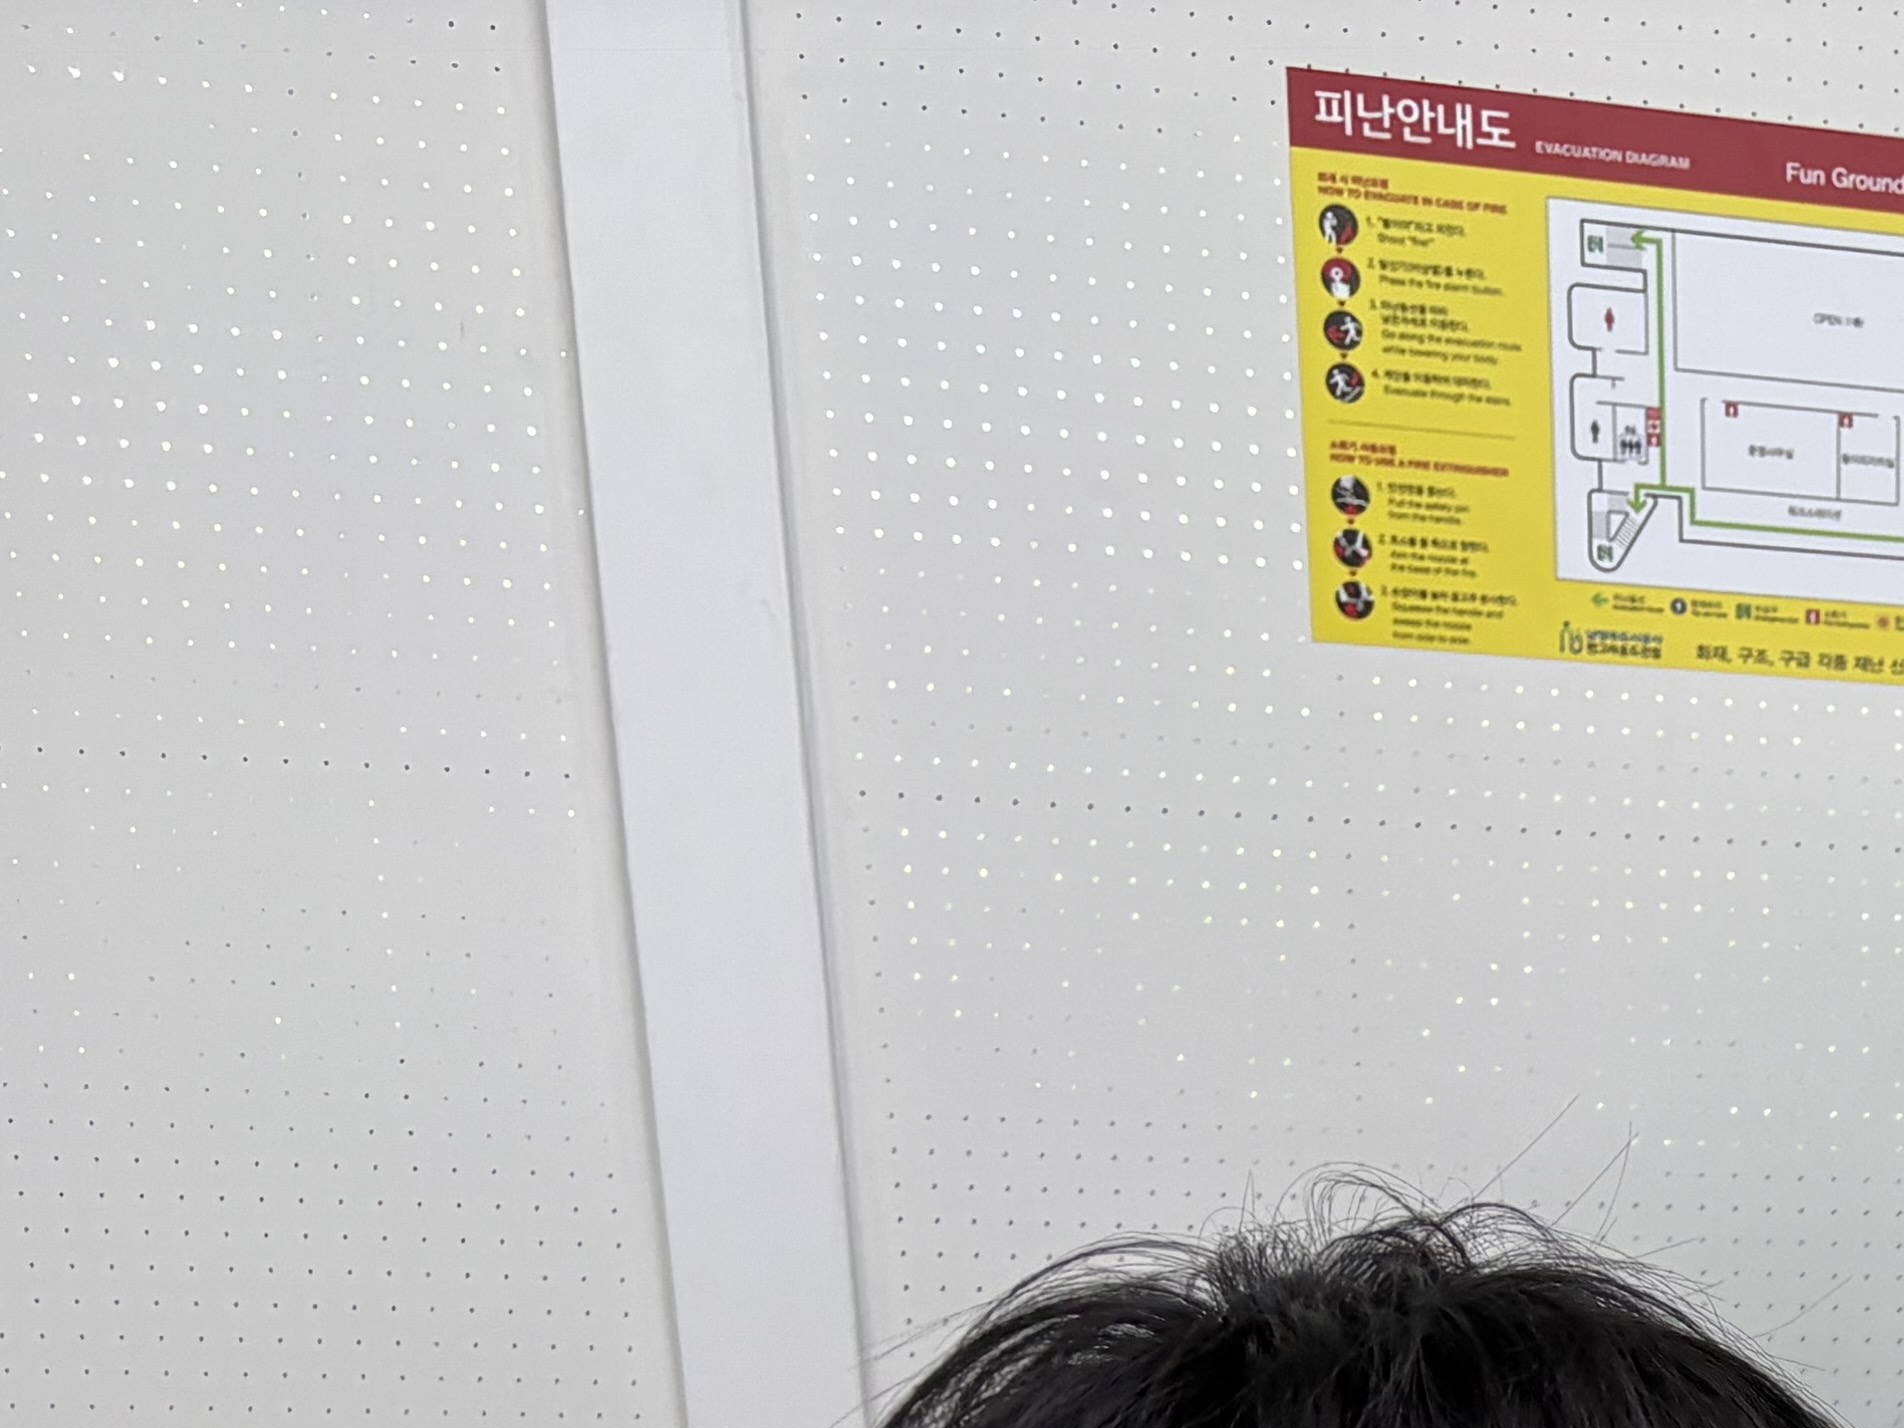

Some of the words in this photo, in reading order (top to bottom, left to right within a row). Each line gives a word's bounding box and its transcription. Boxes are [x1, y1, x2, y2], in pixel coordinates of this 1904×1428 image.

[1315, 90, 1516, 149] 피난안내도
[1535, 141, 1623, 163] EVACUATION
[1625, 150, 1691, 170] DIAGRAM
[1786, 162, 1825, 187] Fun
[1738, 646, 1774, 667] 구조,
